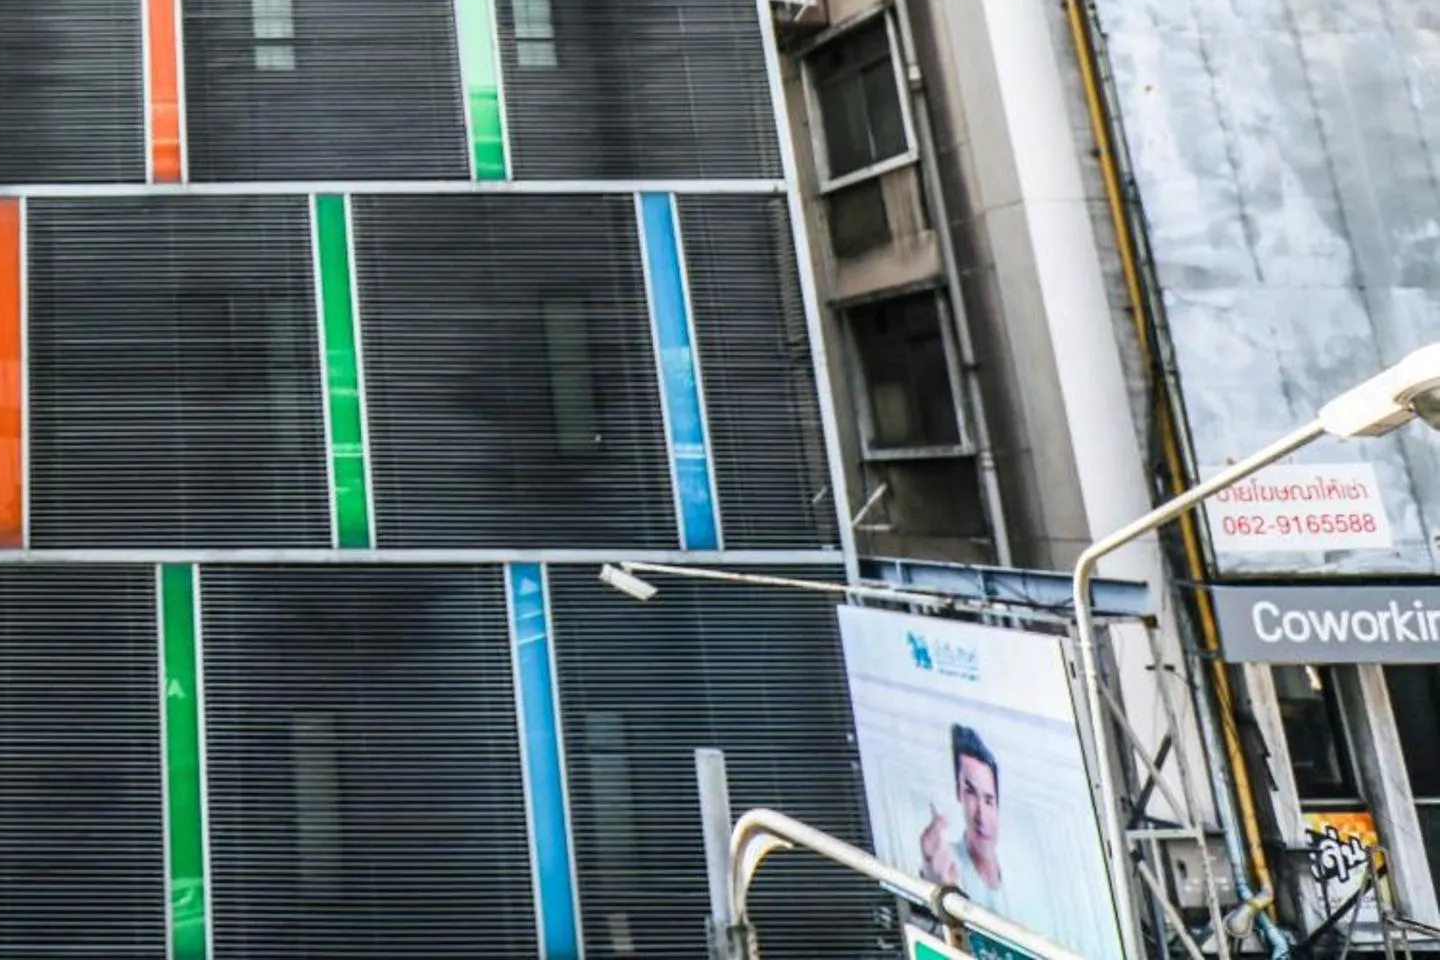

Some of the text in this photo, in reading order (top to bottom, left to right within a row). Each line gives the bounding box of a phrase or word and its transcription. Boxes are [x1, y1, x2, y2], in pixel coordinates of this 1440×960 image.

[1216, 475, 1370, 503] ปายโฆษณาให้เช่า
[1222, 513, 1378, 535] 062-9165588
